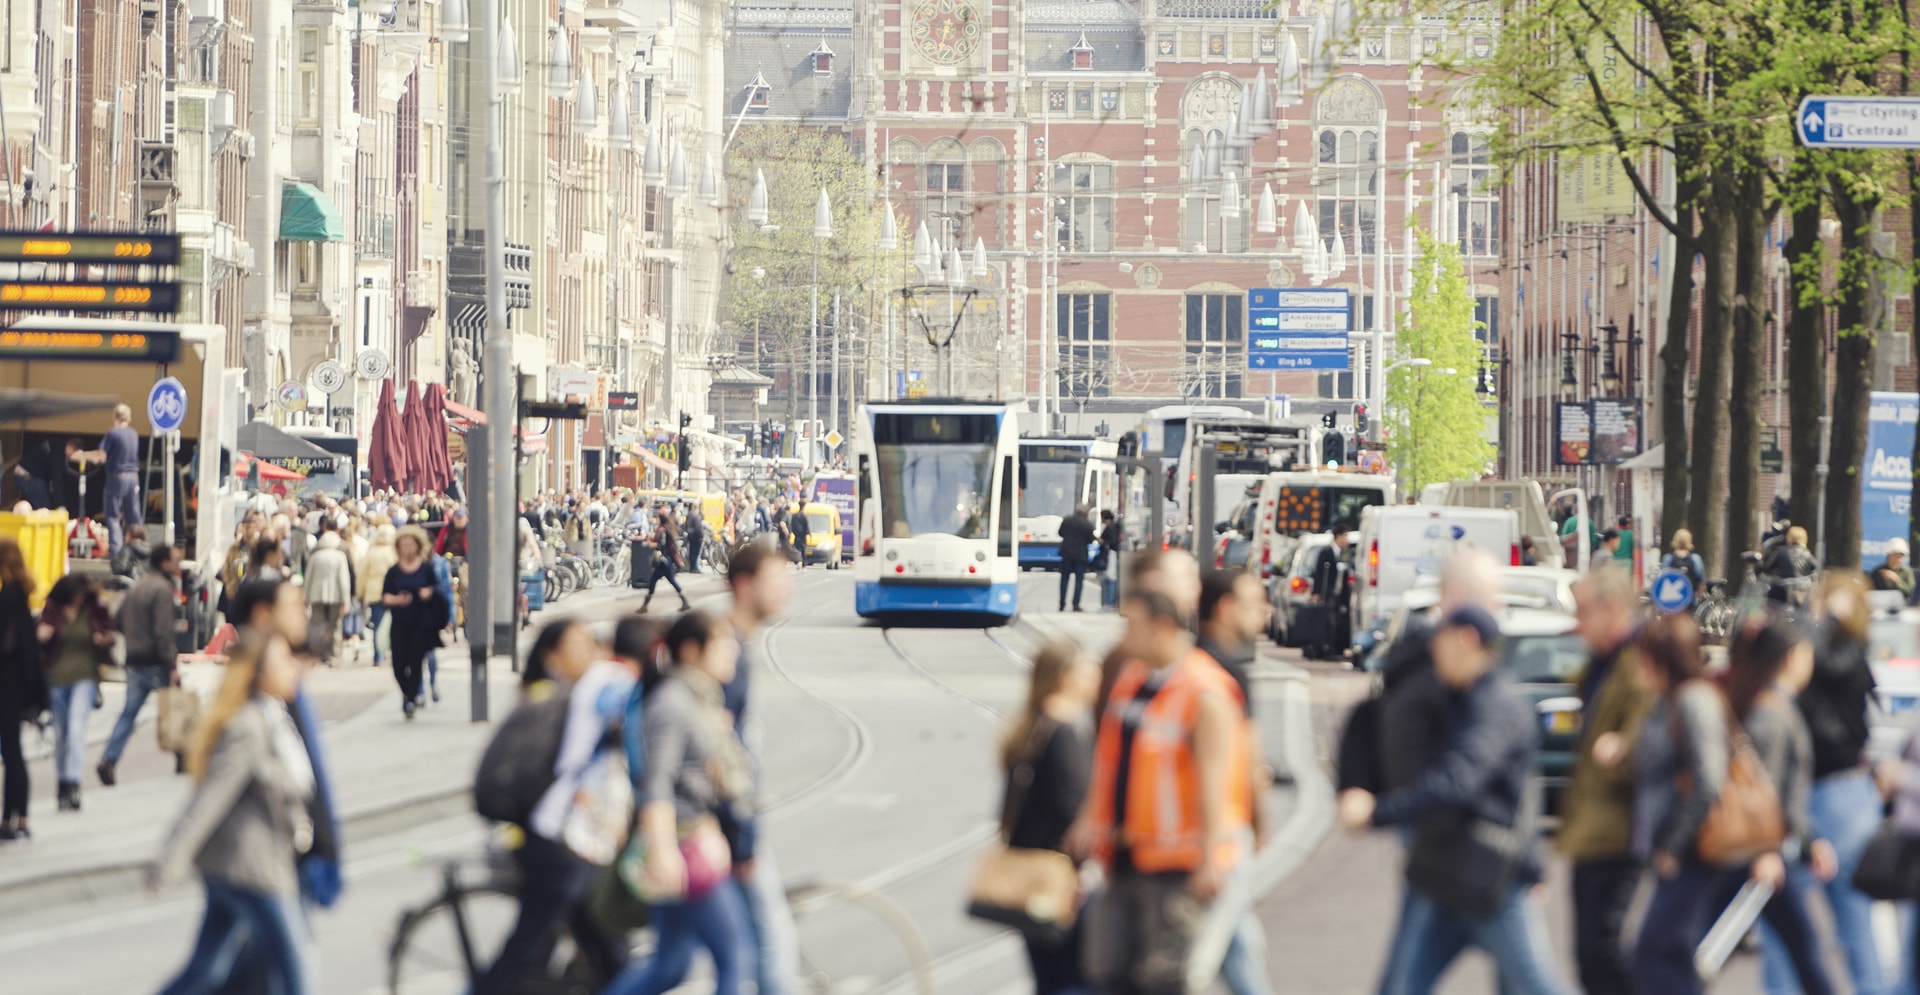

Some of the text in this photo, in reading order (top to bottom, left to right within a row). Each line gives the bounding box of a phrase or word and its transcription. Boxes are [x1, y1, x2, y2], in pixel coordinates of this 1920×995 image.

[1861, 106, 1918, 121] Cityring
[1847, 124, 1908, 135] Centraal
[1278, 357, 1312, 367] Ring A10
